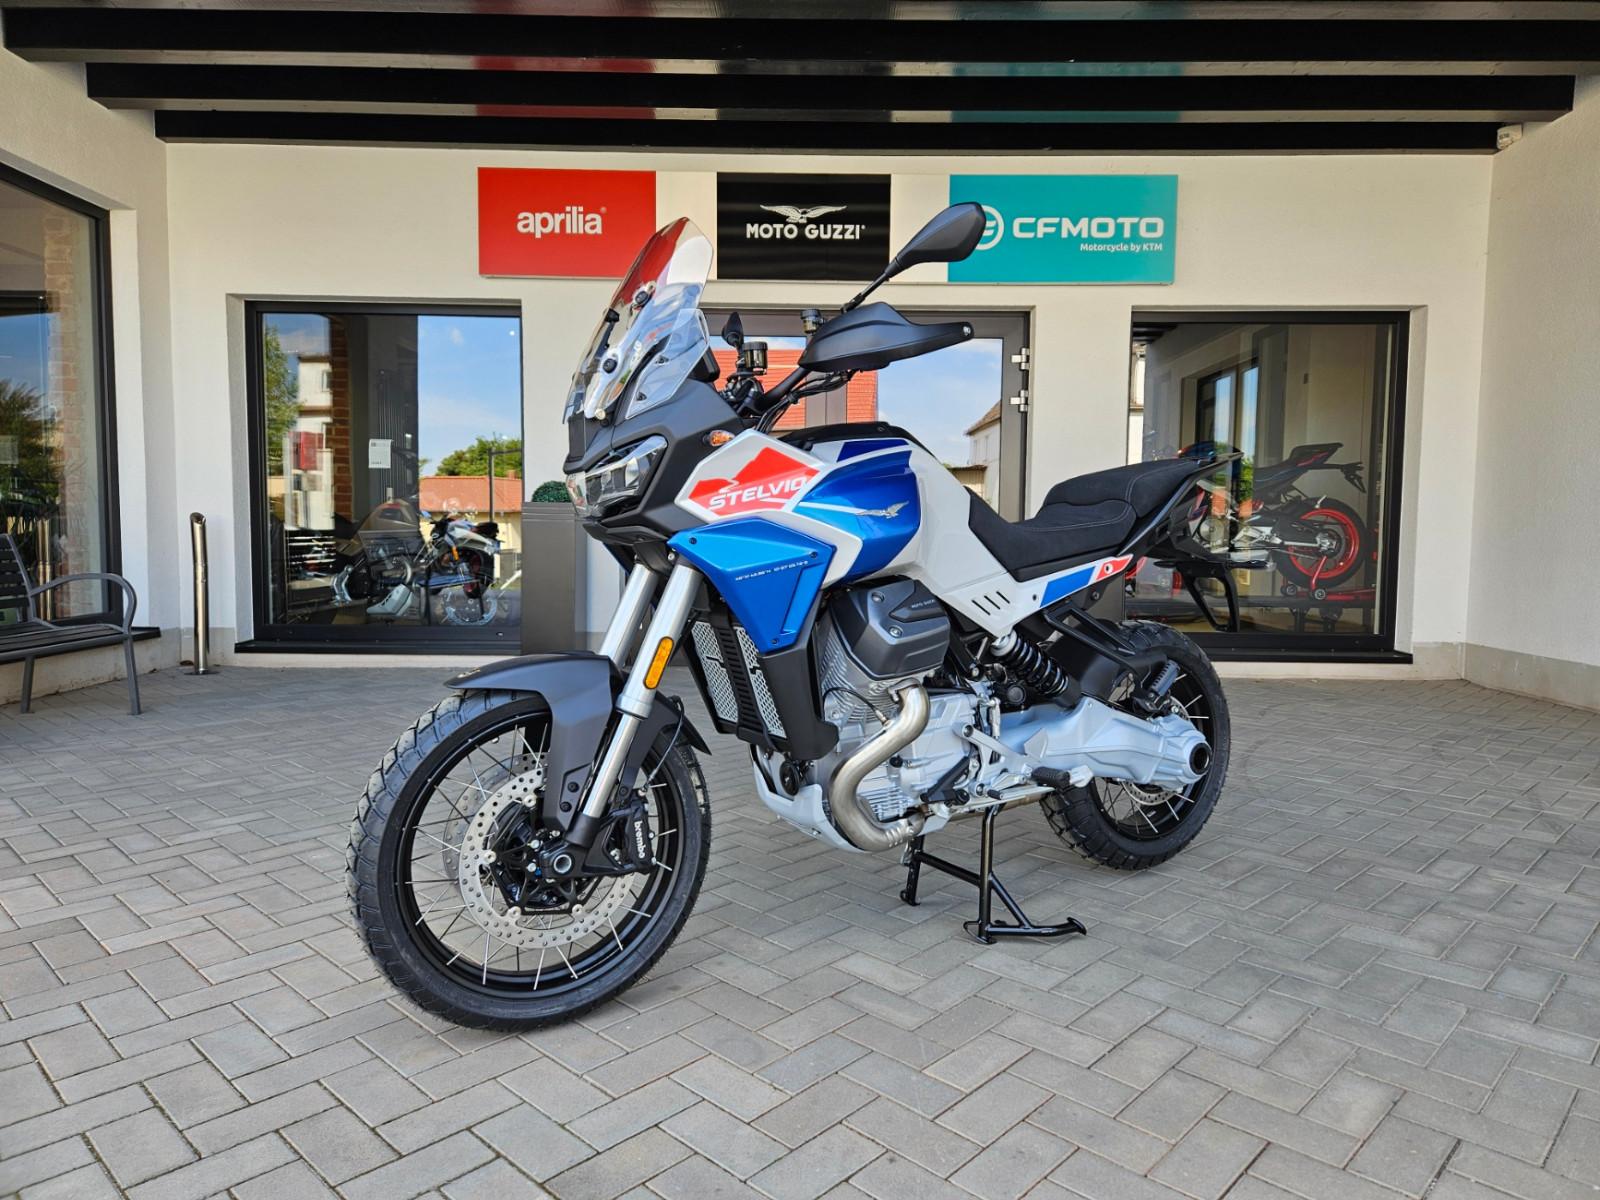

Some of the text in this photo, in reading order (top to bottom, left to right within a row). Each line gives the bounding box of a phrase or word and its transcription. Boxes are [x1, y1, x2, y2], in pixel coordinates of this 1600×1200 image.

[517, 206, 602, 238] aprilia
[746, 223, 860, 239] MOTO GUZZI
[1012, 217, 1164, 239] CFMOTO
[1080, 242, 1163, 252] Motorcycle by KTM
[708, 477, 807, 510] STELVIO
[634, 820, 646, 859] brembo
